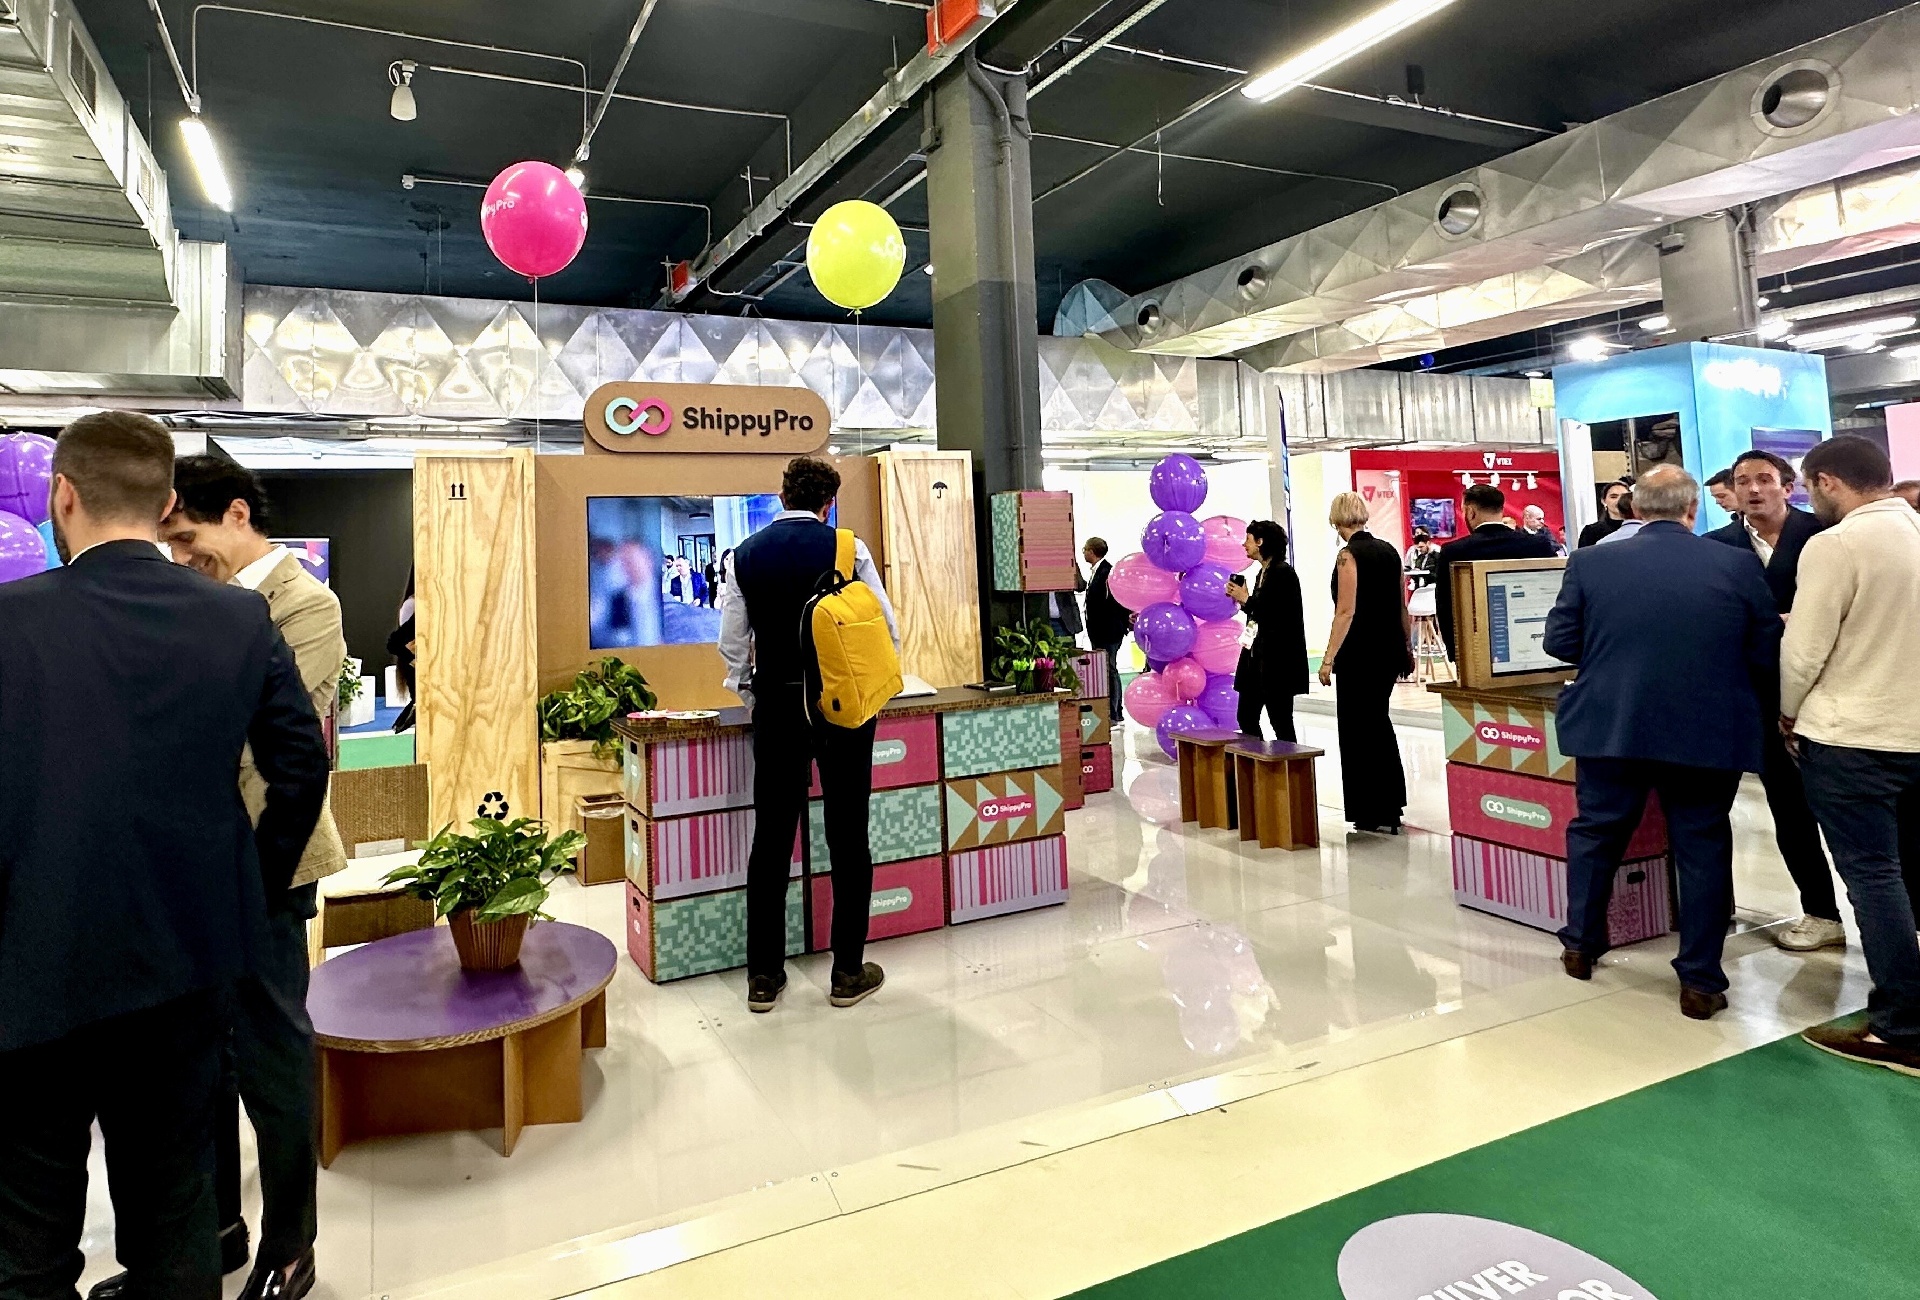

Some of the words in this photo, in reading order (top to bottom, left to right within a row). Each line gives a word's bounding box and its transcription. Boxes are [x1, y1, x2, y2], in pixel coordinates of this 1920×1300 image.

[682, 406, 814, 437] ShippyPro
[1495, 457, 1513, 466] VTEX
[1376, 490, 1395, 499] VTEX
[1500, 731, 1541, 744] ShippyPro
[999, 802, 1032, 812] ShippyPro
[1506, 806, 1546, 821] ShippyPro
[872, 896, 908, 908] ShippyPro
[1417, 1260, 1549, 1300] ILVER
